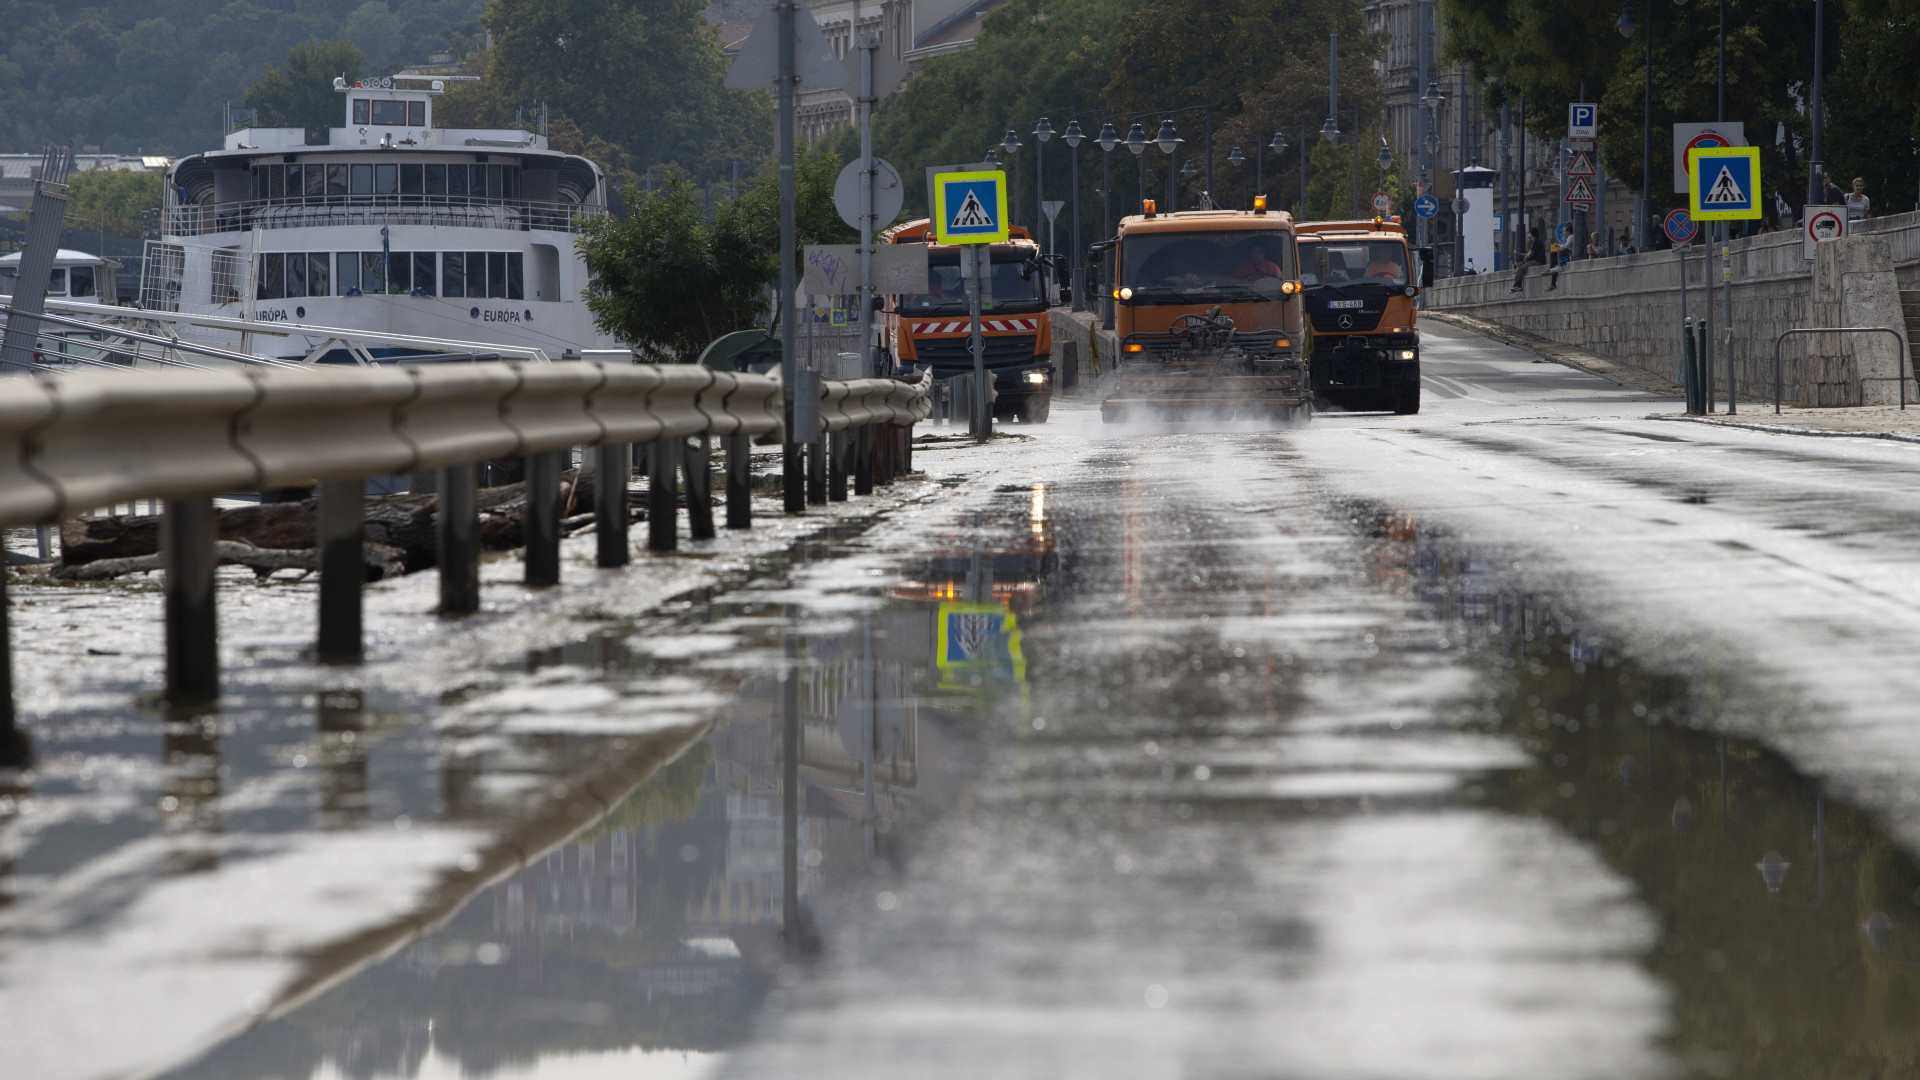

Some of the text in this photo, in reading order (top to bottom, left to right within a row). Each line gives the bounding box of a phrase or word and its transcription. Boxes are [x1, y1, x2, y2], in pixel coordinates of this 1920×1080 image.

[1576, 107, 1590, 126] P
[1331, 300, 1362, 308] LXS-468
[253, 306, 288, 321] URÓPA
[483, 307, 520, 323] EURÓPA
